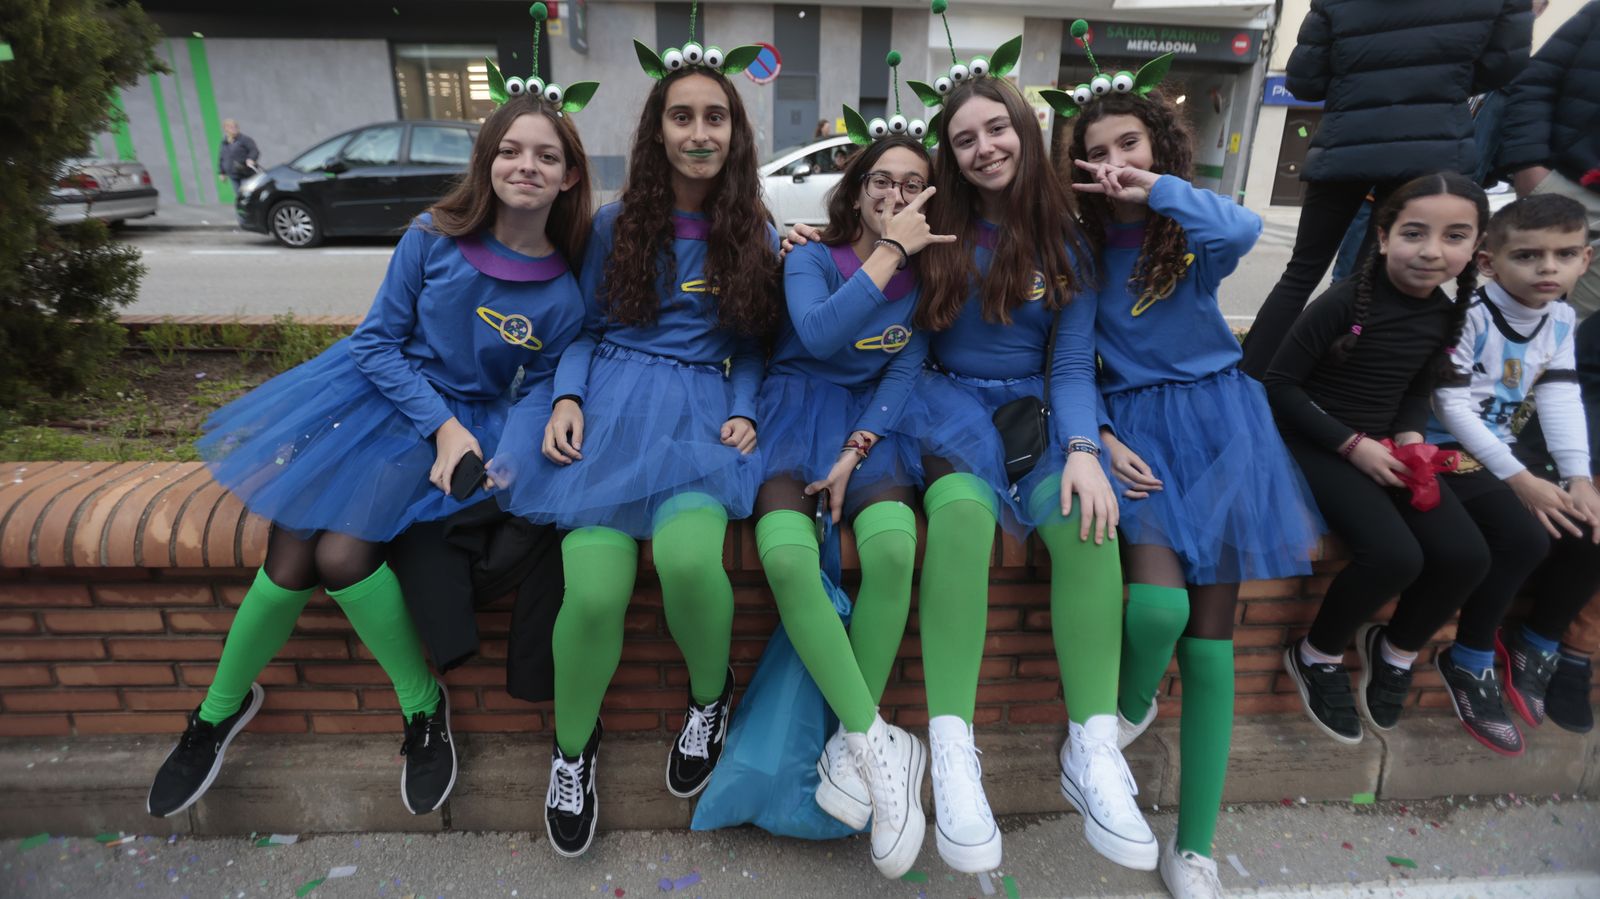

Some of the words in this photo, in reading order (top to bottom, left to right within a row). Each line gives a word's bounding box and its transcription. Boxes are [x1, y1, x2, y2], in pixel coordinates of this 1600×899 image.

[1106, 25, 1157, 40] SALIDA
[1160, 27, 1220, 43] PARKING
[1126, 39, 1197, 53] MERCADONA
